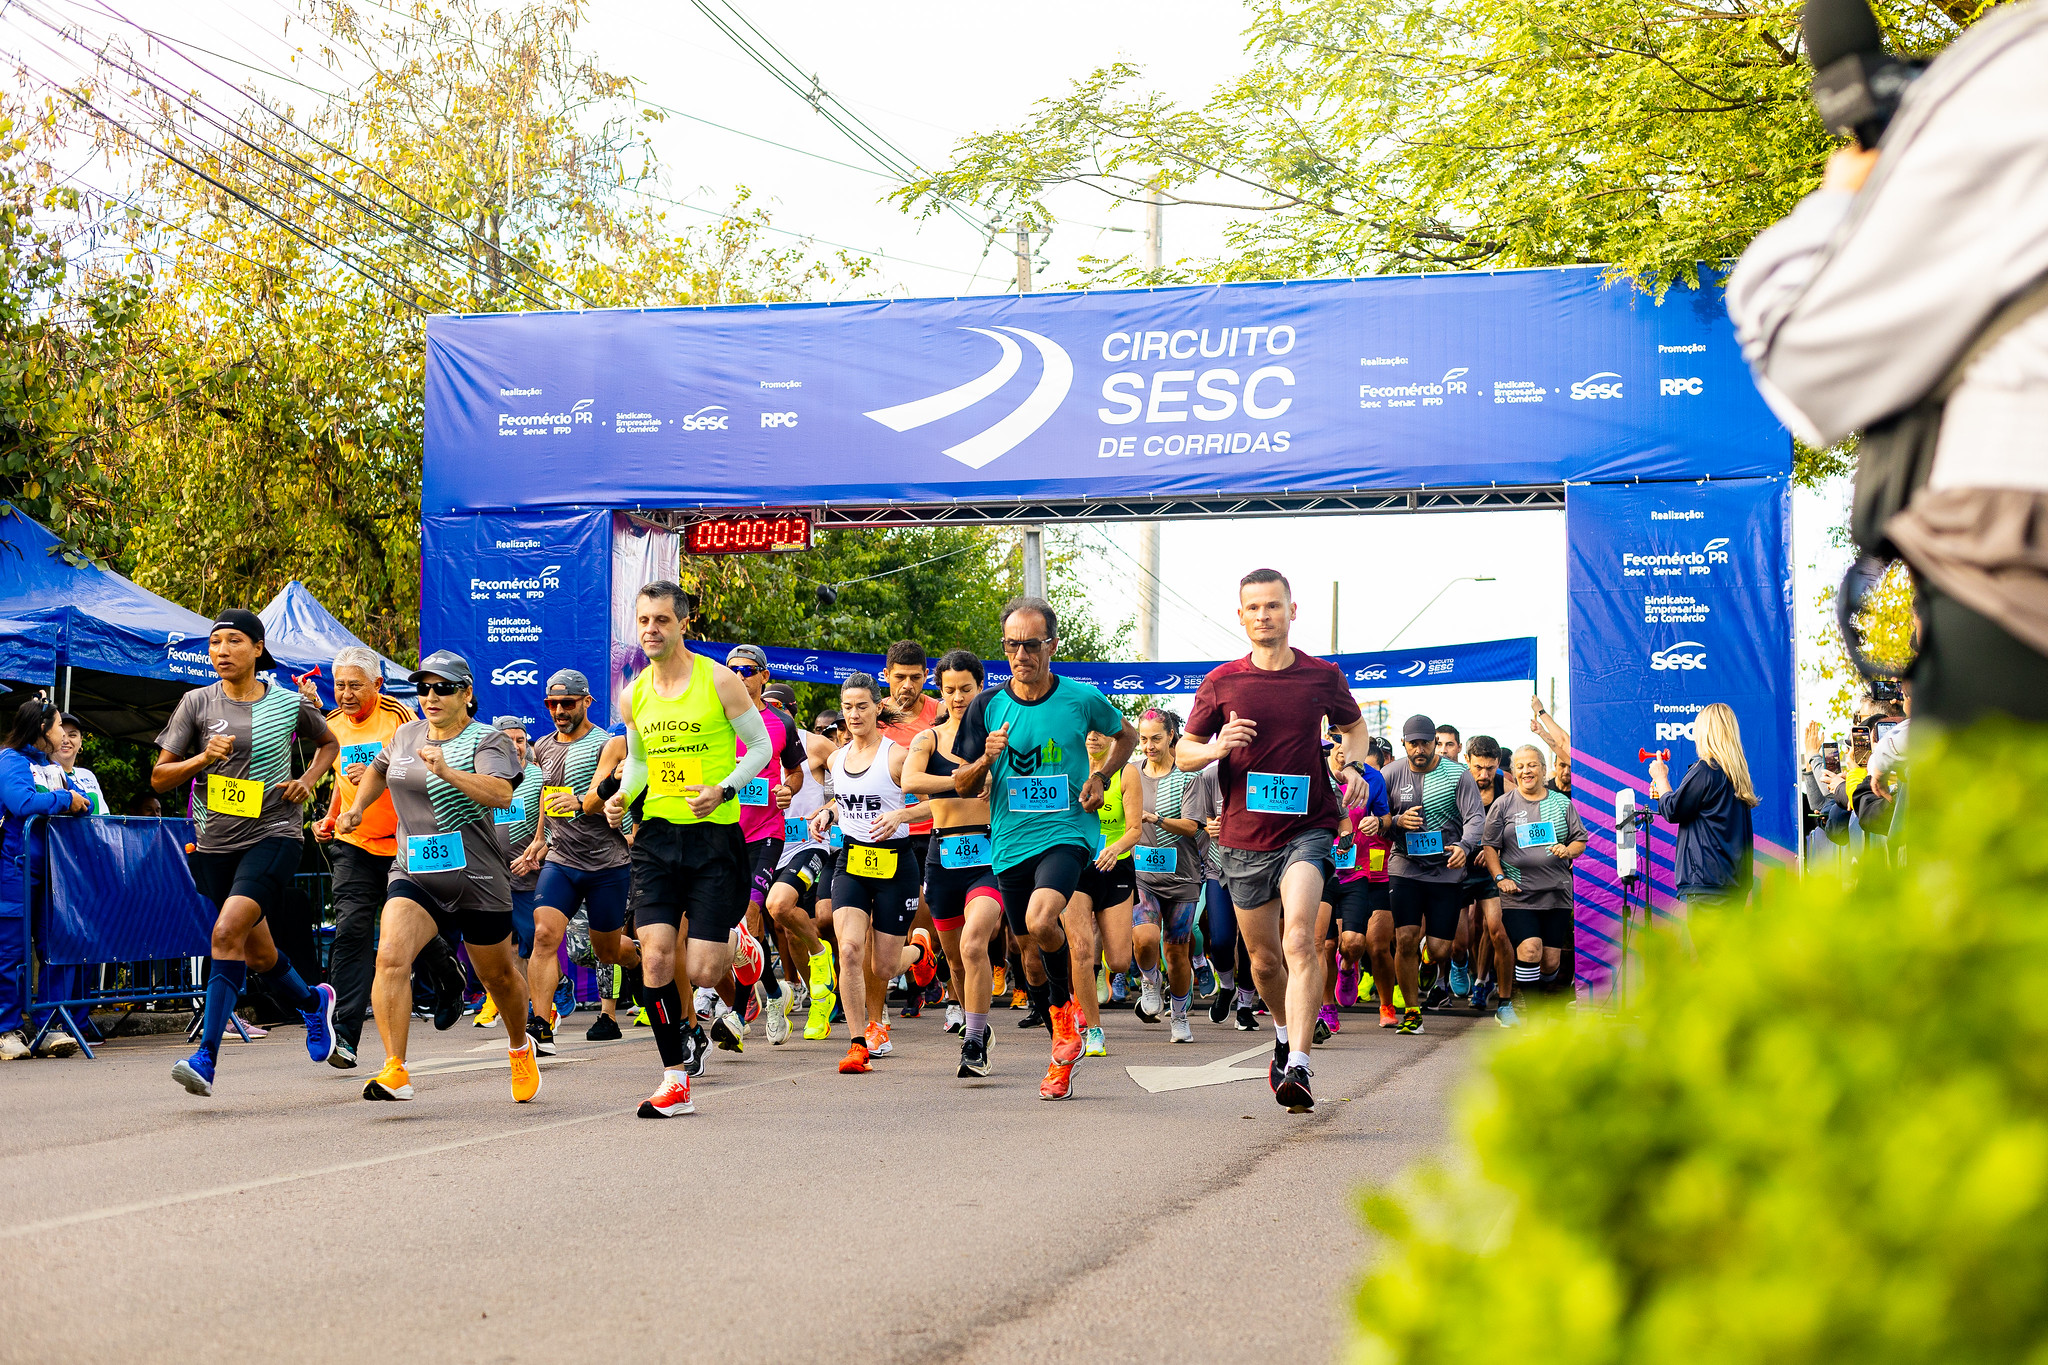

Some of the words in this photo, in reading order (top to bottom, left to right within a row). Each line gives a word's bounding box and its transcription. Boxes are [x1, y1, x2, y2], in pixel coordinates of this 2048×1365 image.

[1102, 325, 1296, 362] CIRCUITO
[1658, 343, 1707, 354] Promoção:
[1360, 356, 1409, 367] Realização:
[760, 380, 802, 390] Promoção:
[1360, 382, 1443, 398] Fecomércio
[1447, 381, 1468, 395] PR
[1494, 381, 1536, 389] Sindicatos
[1660, 377, 1703, 396] RPC
[500, 387, 542, 397] Realização:
[1098, 365, 1296, 425] SESC
[1494, 388, 1547, 397] Empresariais
[1360, 400, 1382, 409] Sesc
[1388, 399, 1416, 408] Senac
[1422, 397, 1444, 406] IFPD
[1494, 395, 1505, 404] do
[1507, 395, 1544, 403] Comércio
[499, 412, 572, 426] Fecomércio
[575, 412, 593, 424] PR
[616, 412, 652, 420] Sindicatos
[760, 411, 799, 428] RPC
[616, 419, 662, 427] Empresariais
[499, 427, 518, 436] Sesc
[523, 427, 548, 435] Senac
[553, 426, 571, 434] IFPD
[616, 426, 626, 434] do
[1098, 436, 1137, 458] DE
[1143, 431, 1291, 456] CORRIDAS
[1651, 510, 1704, 521] Realização:
[697, 519, 806, 547] 00:00:03
[496, 540, 541, 550] Realização:
[771, 543, 805, 551] ChipTiming
[1623, 551, 1705, 566] Fecomércio
[1708, 551, 1728, 564] PR
[1623, 567, 1645, 576] Sesc
[1653, 567, 1682, 576] Senac
[1689, 566, 1710, 575] IFPD
[471, 578, 540, 590] Fecomércio
[543, 577, 559, 588] PR
[471, 592, 490, 600] Sesc
[496, 591, 520, 599] Senac
[526, 591, 544, 599] IFPD
[1644, 595, 1695, 605] Sindicatos
[1644, 604, 1710, 614] Empresariais
[488, 617, 531, 626] Sindicatos
[1644, 614, 1658, 623] do
[1661, 613, 1706, 622] Comércio
[488, 625, 543, 634] Empresariais
[487, 634, 499, 642] do
[501, 633, 539, 642] Comércio
[1650, 645, 1706, 670] Sesc
[169, 663, 183, 673] Sesc
[188, 667, 204, 677] Senac
[807, 664, 819, 672] PR
[1428, 663, 1454, 672] SESC
[491, 662, 538, 685] Sesc
[1184, 678, 1203, 686] SES
[644, 721, 702, 736] AMIGOS
[662, 735, 677, 743] DE
[354, 745, 363, 753] 5k
[350, 751, 375, 764] 1295
[663, 761, 676, 769] 10k
[661, 770, 685, 783] 234
[1273, 776, 1285, 785] 5k
[225, 780, 238, 789] 10k
[1031, 778, 1043, 787] 5k
[221, 788, 246, 802] 120
[1022, 786, 1057, 799] 1230
[1262, 785, 1299, 800] 1167
[1529, 829, 1545, 839] 880
[427, 836, 438, 846] 5k
[960, 837, 970, 845] 5k
[1415, 838, 1437, 848] 1119
[422, 845, 449, 860] 883
[955, 843, 979, 856] 484
[865, 856, 878, 867] 61
[1146, 855, 1165, 865] 463
